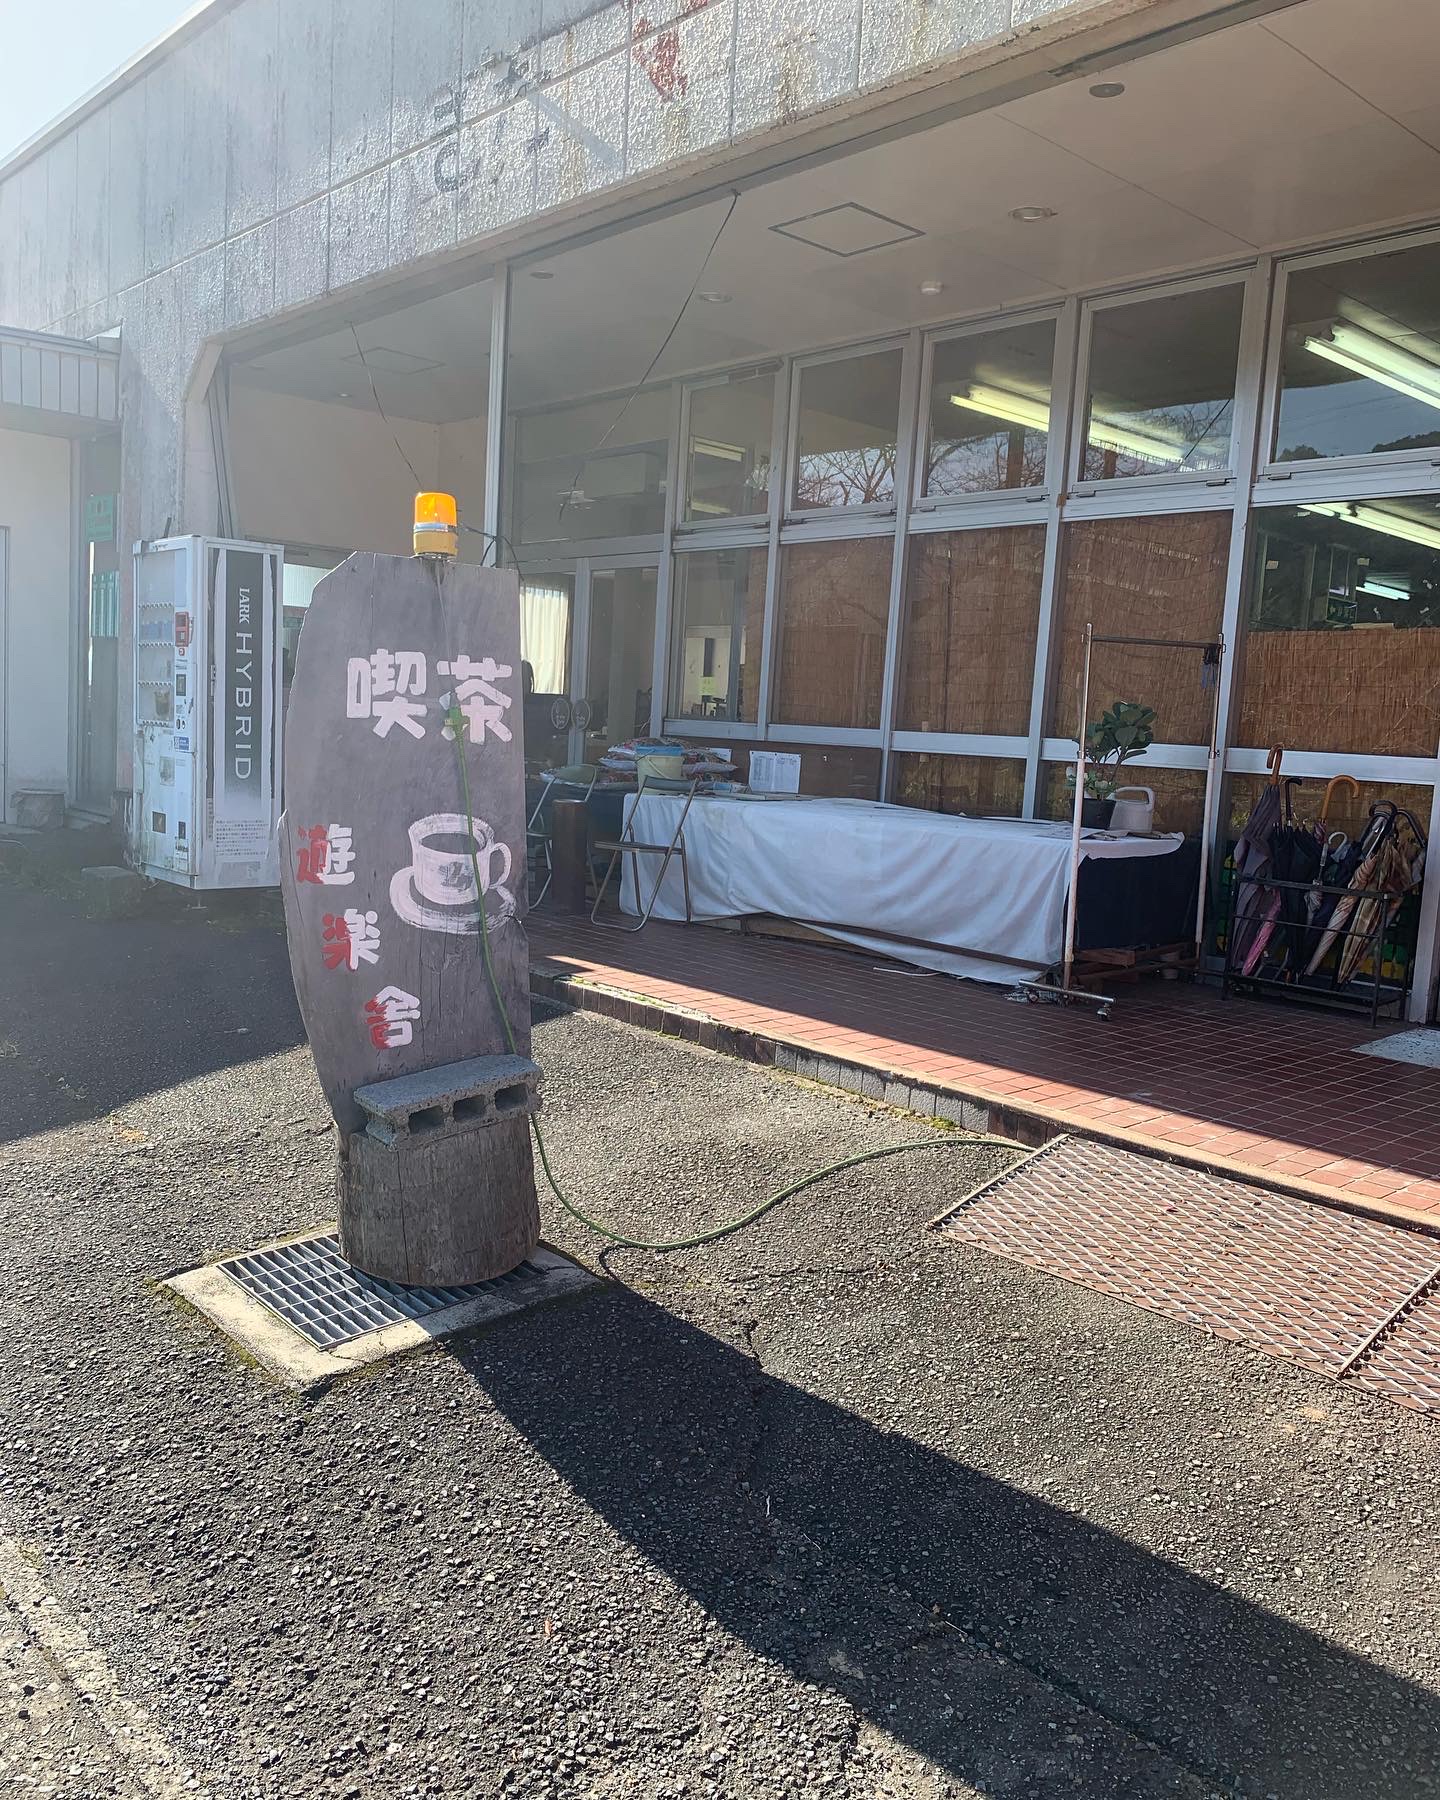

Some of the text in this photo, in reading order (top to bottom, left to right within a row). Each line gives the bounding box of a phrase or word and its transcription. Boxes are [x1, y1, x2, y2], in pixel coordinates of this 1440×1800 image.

[235, 588, 253, 780] LARK HYBRID
[346, 648, 513, 745] 喫茶
[296, 823, 422, 1050] 遊楽舎
